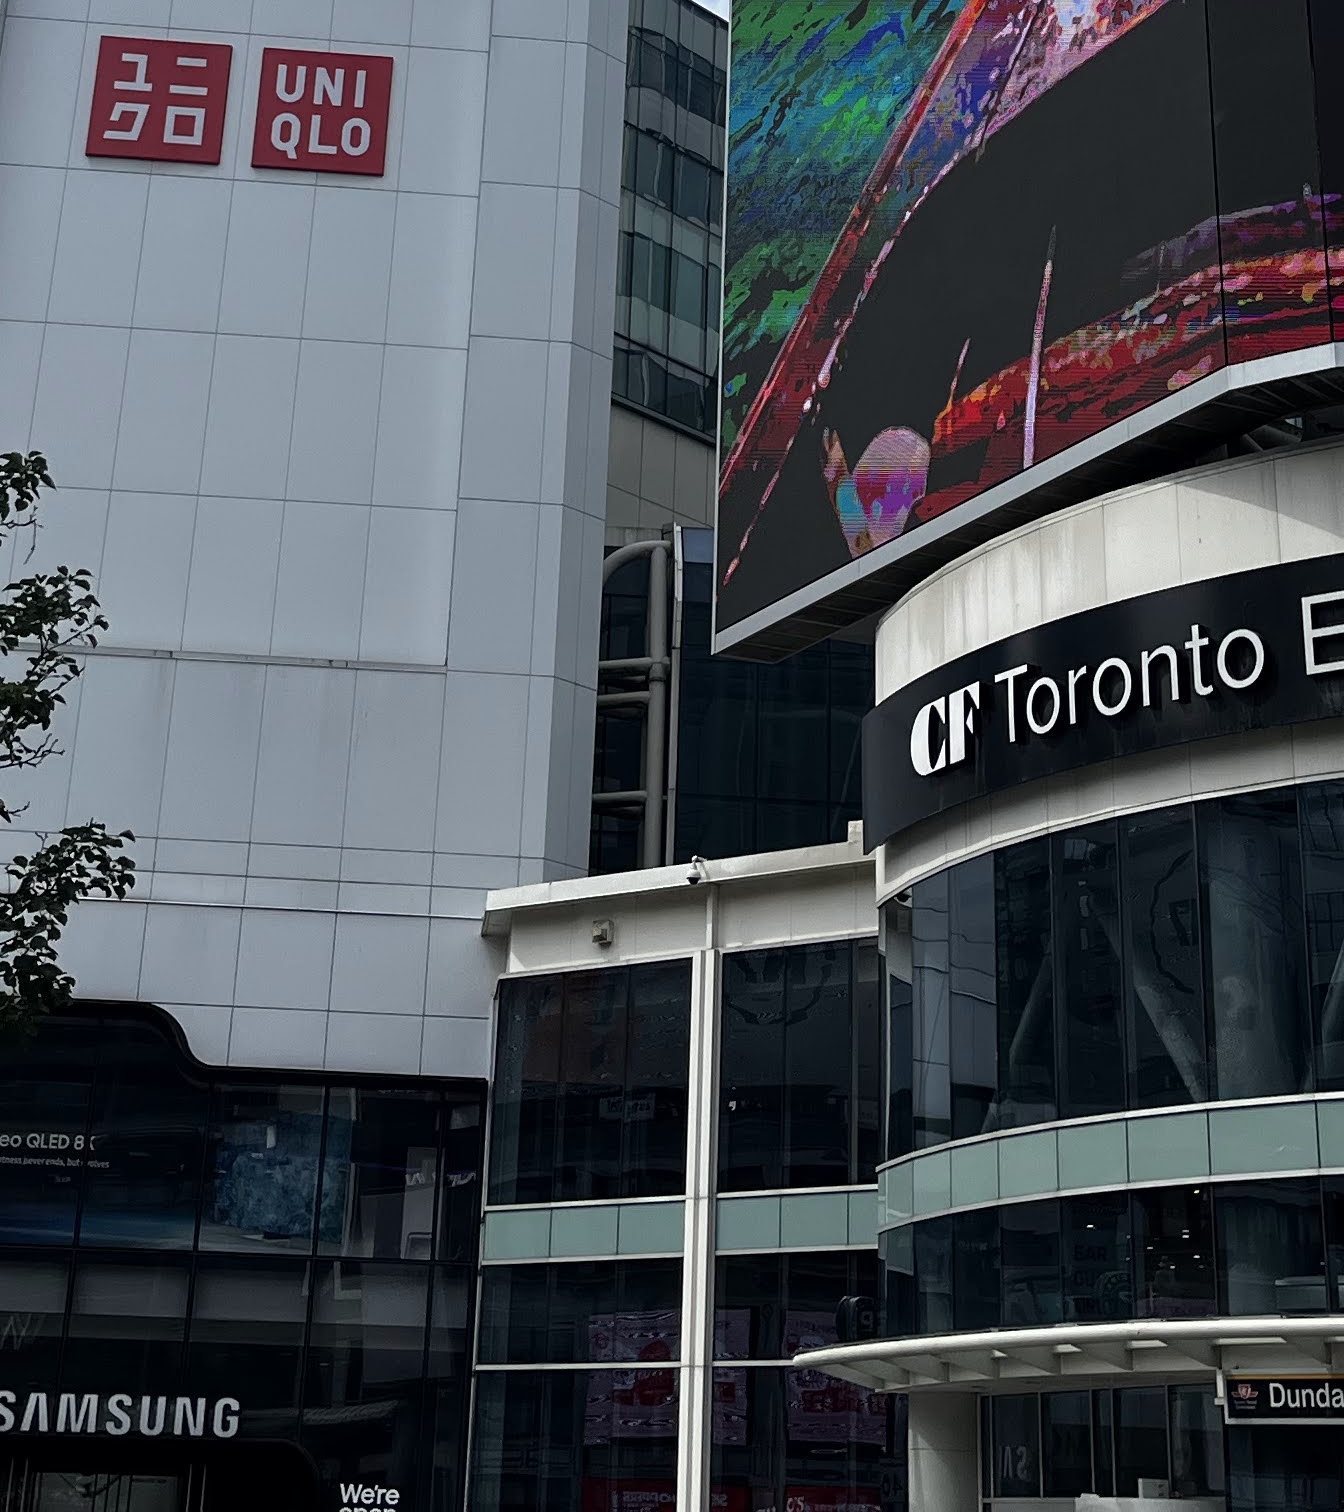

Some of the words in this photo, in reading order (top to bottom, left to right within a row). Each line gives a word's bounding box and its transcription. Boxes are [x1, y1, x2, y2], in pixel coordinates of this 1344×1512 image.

[275, 63, 367, 109] UNI
[270, 112, 371, 160] QLO
[910, 681, 980, 776] CF
[996, 624, 1265, 744] Toronto
[26, 1133, 70, 1149] QLED
[339, 1482, 400, 1505] We're
